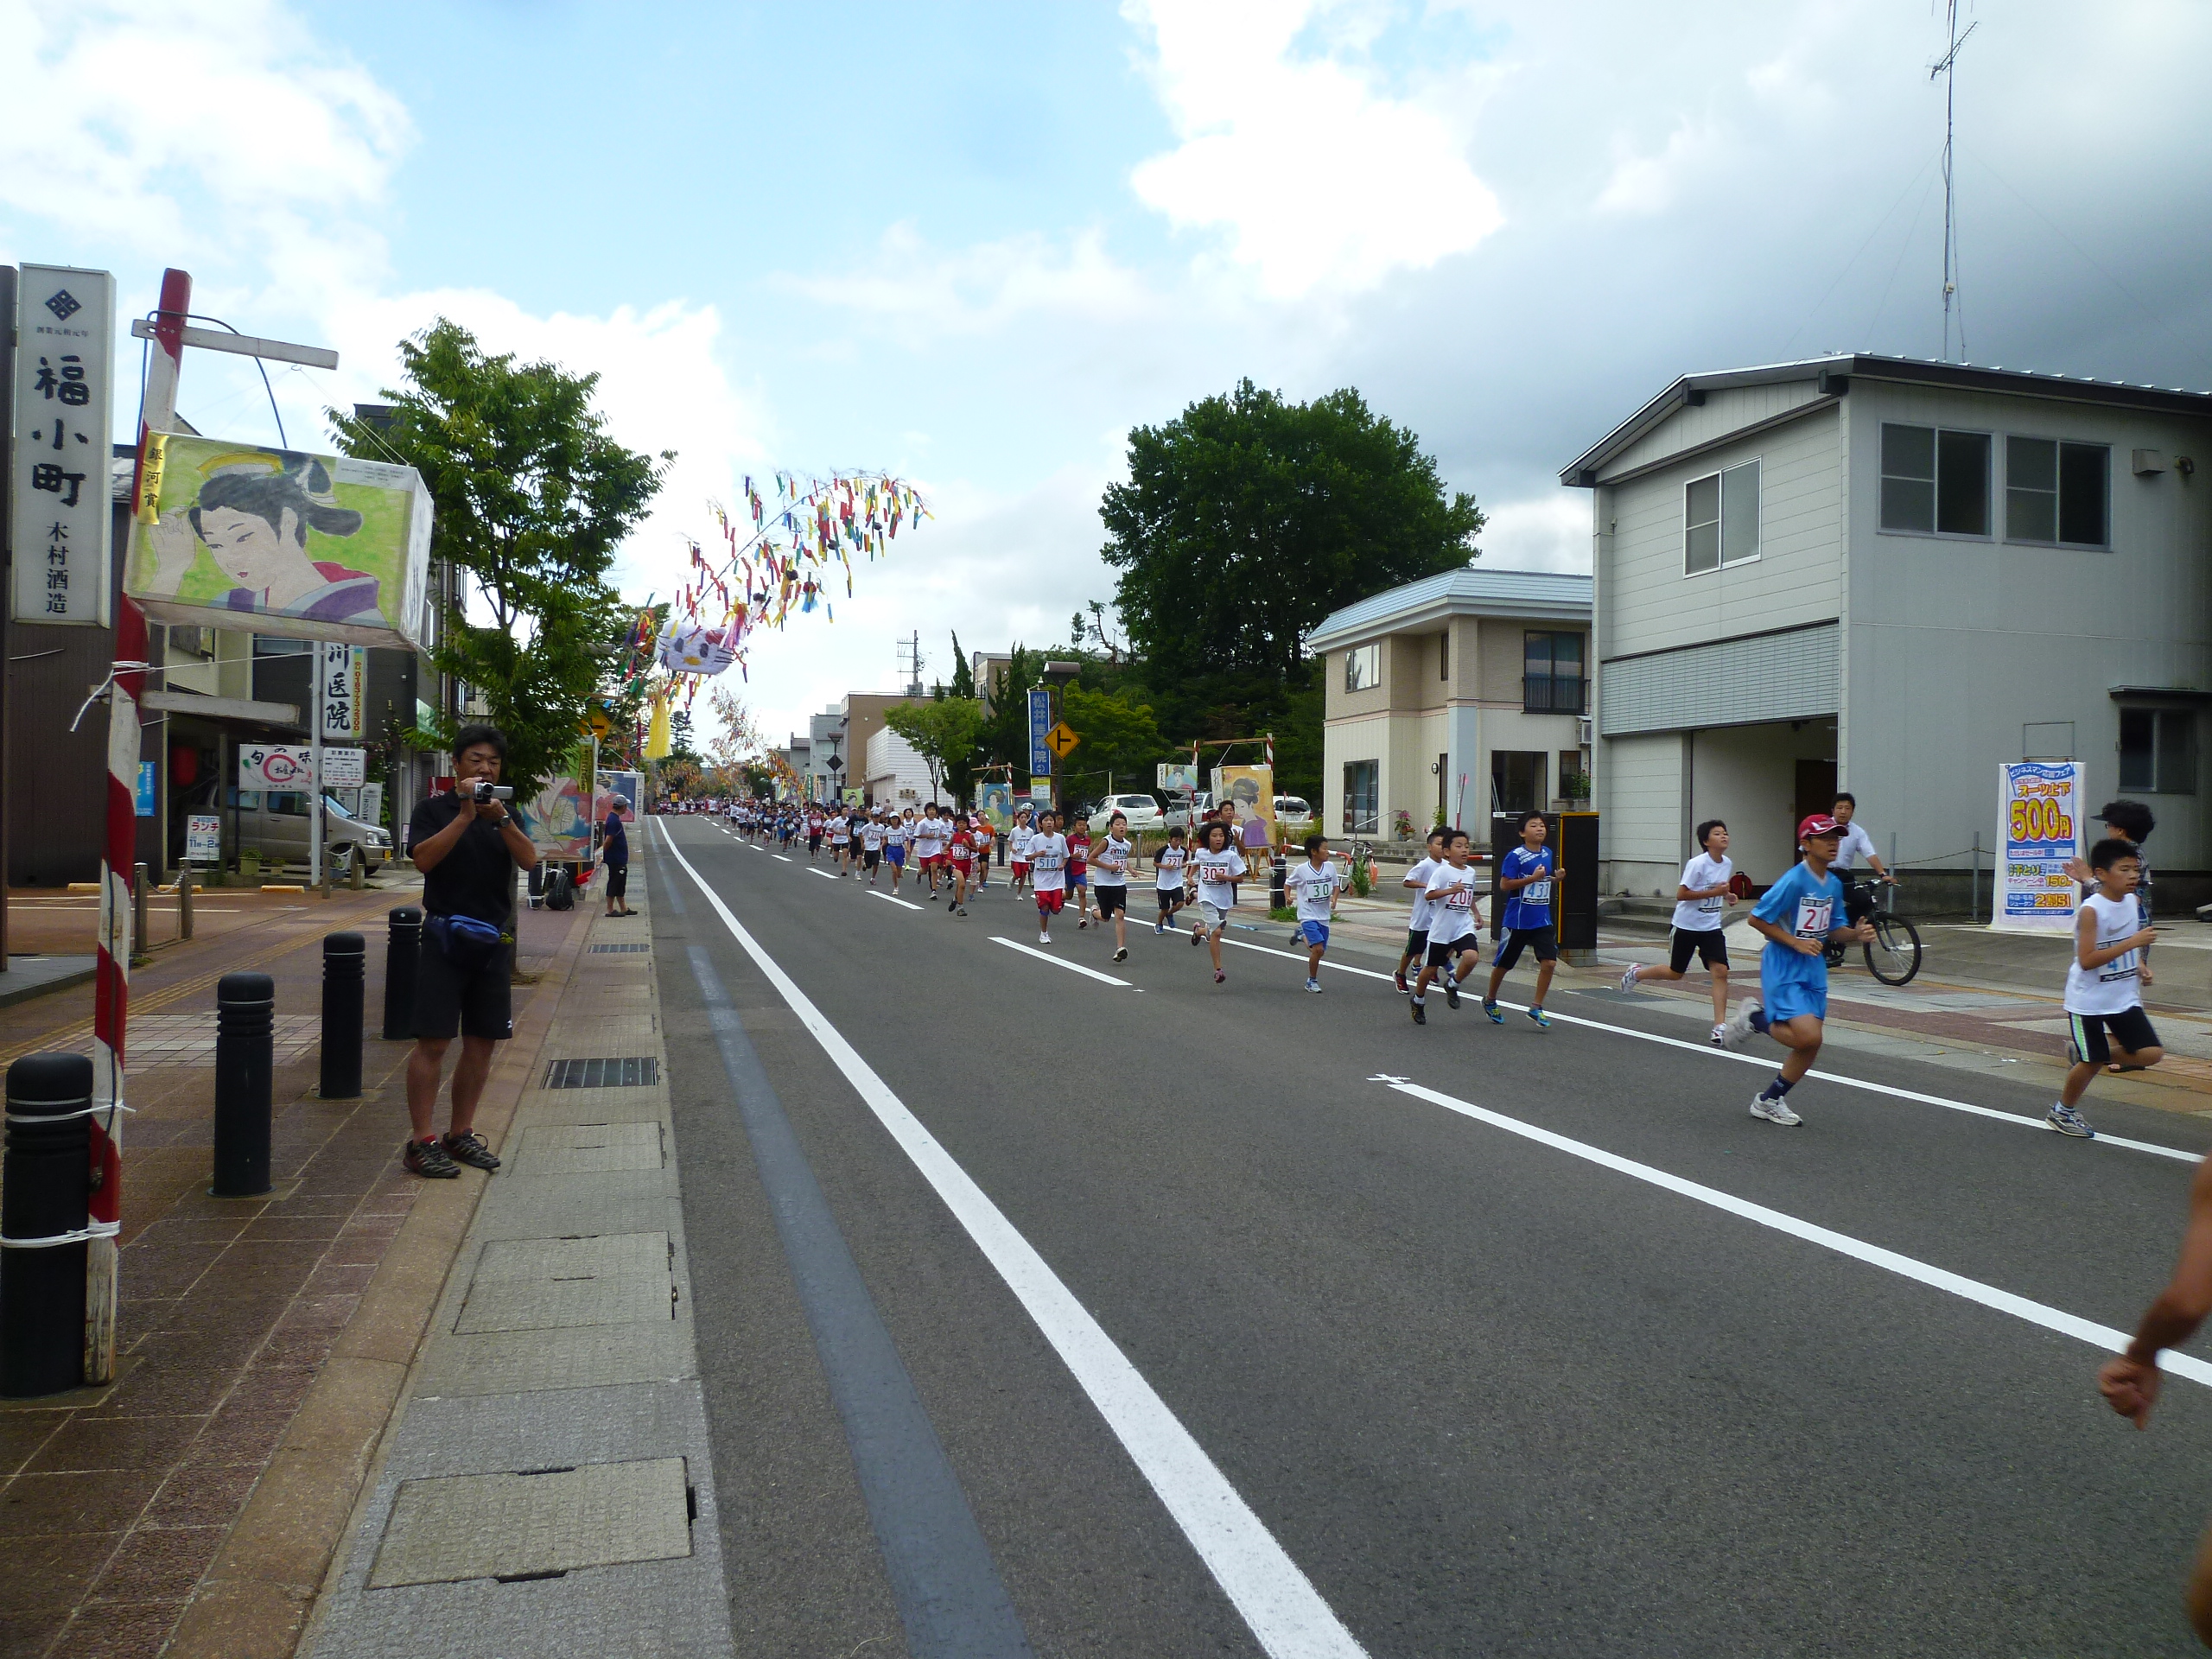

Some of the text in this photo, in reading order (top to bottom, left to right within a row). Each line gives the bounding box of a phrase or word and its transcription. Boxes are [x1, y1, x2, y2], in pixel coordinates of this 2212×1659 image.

[32, 355, 91, 507] 福小町
[145, 447, 164, 508] 銀河賞
[46, 521, 70, 613] 木村酒造
[2018, 782, 2071, 798] スーツ上下
[192, 822, 219, 831] ランチ
[2010, 798, 2072, 842] 500円
[1039, 858, 1057, 868] 510
[1313, 884, 1329, 898] 30
[2034, 893, 2071, 908] 2割引
